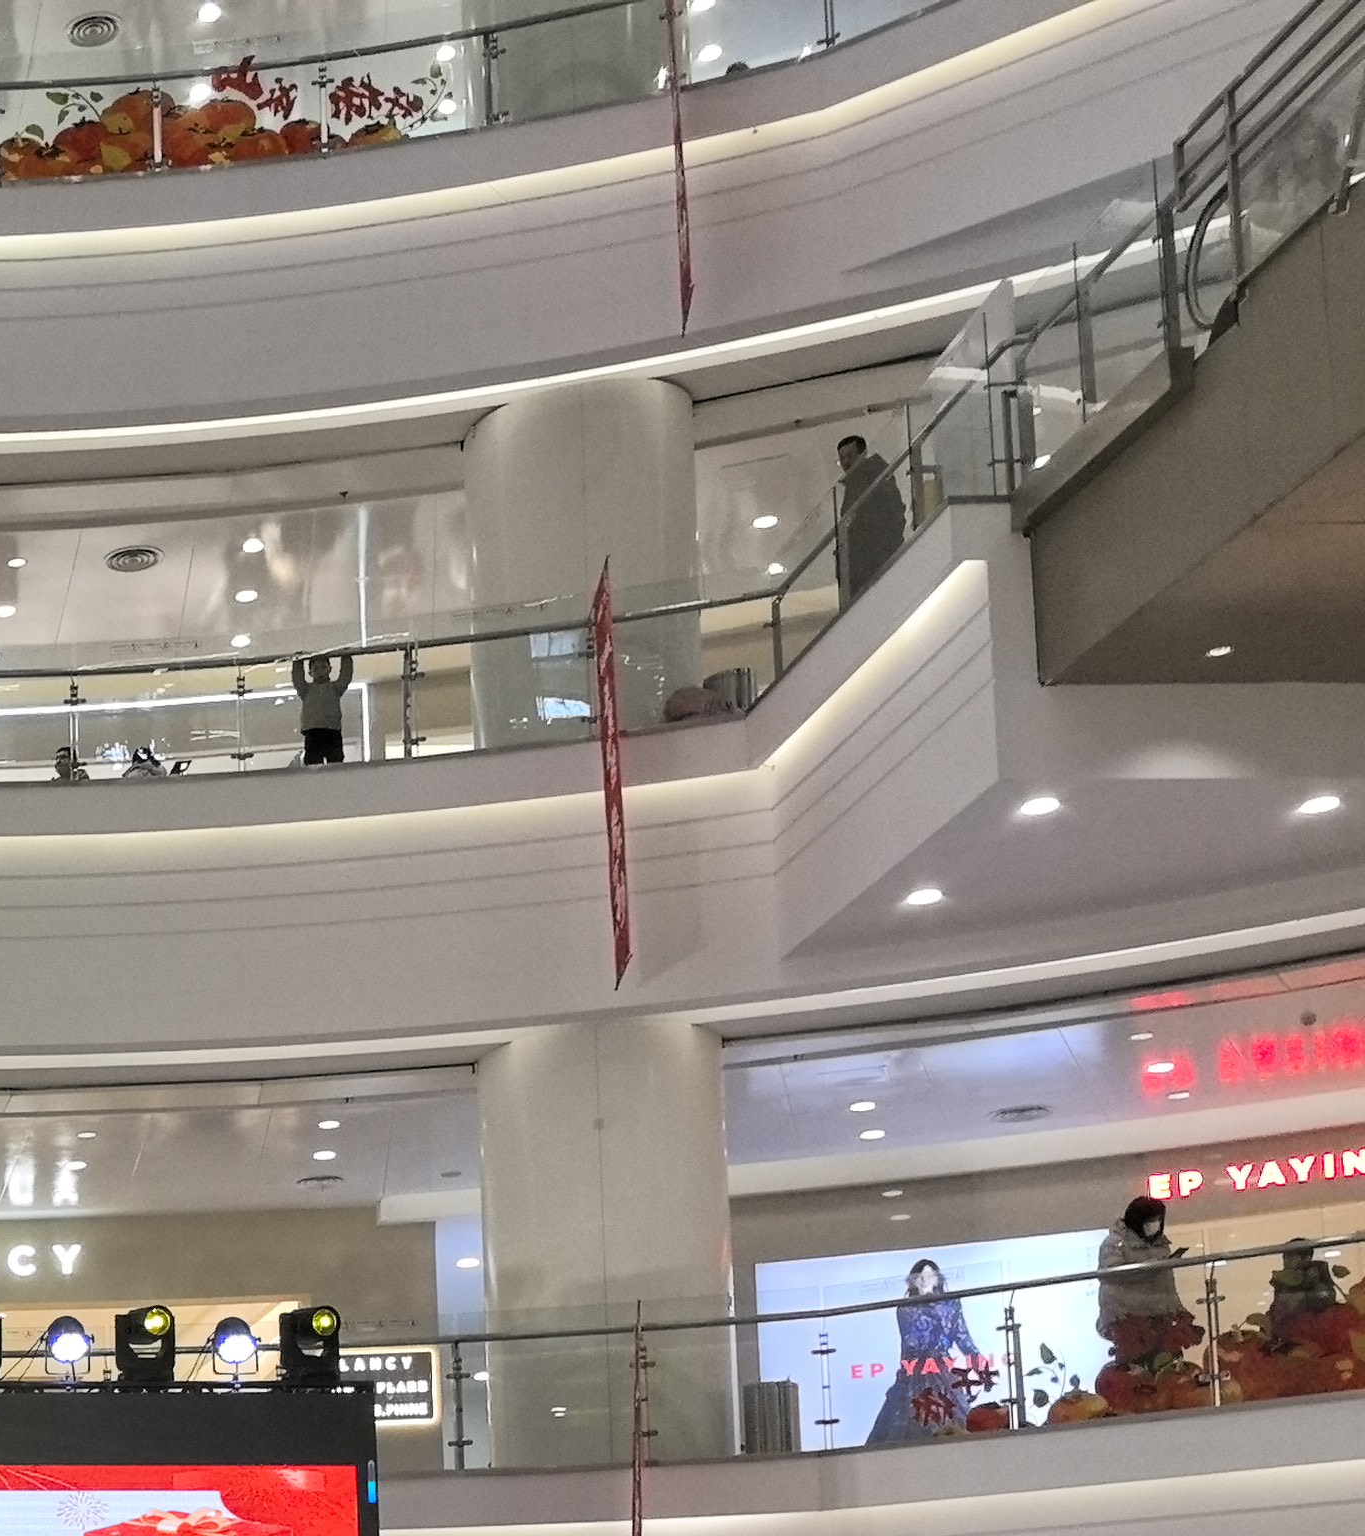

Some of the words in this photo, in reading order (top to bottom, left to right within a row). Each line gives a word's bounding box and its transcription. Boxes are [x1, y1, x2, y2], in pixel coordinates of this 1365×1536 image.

[1148, 1171, 1205, 1201] EP
[339, 1356, 413, 1372] LANCY
[851, 1363, 885, 1379] EP
